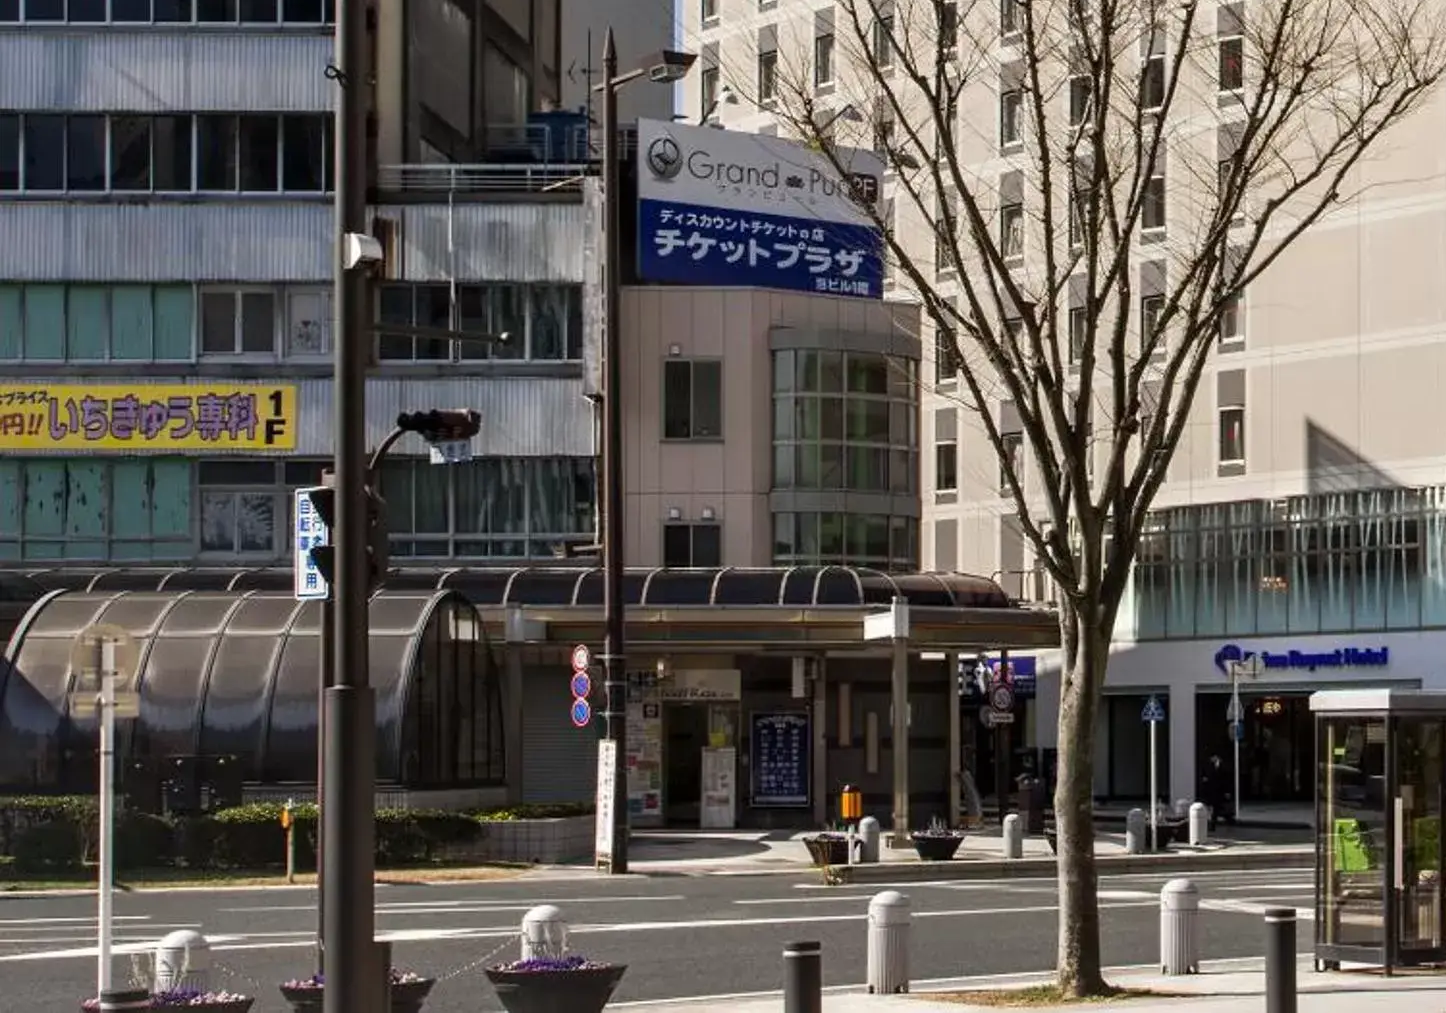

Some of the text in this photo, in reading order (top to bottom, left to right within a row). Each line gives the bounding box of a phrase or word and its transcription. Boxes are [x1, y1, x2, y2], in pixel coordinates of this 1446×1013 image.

[687, 150, 779, 189] Grand
[660, 209, 825, 243] ディスカウントチケットの店
[654, 228, 867, 277] チケットプラザ
[0, 412, 44, 437] 円!!
[49, 390, 260, 441] いちきゅう専科
[1343, 646, 1389, 666] Hotel
